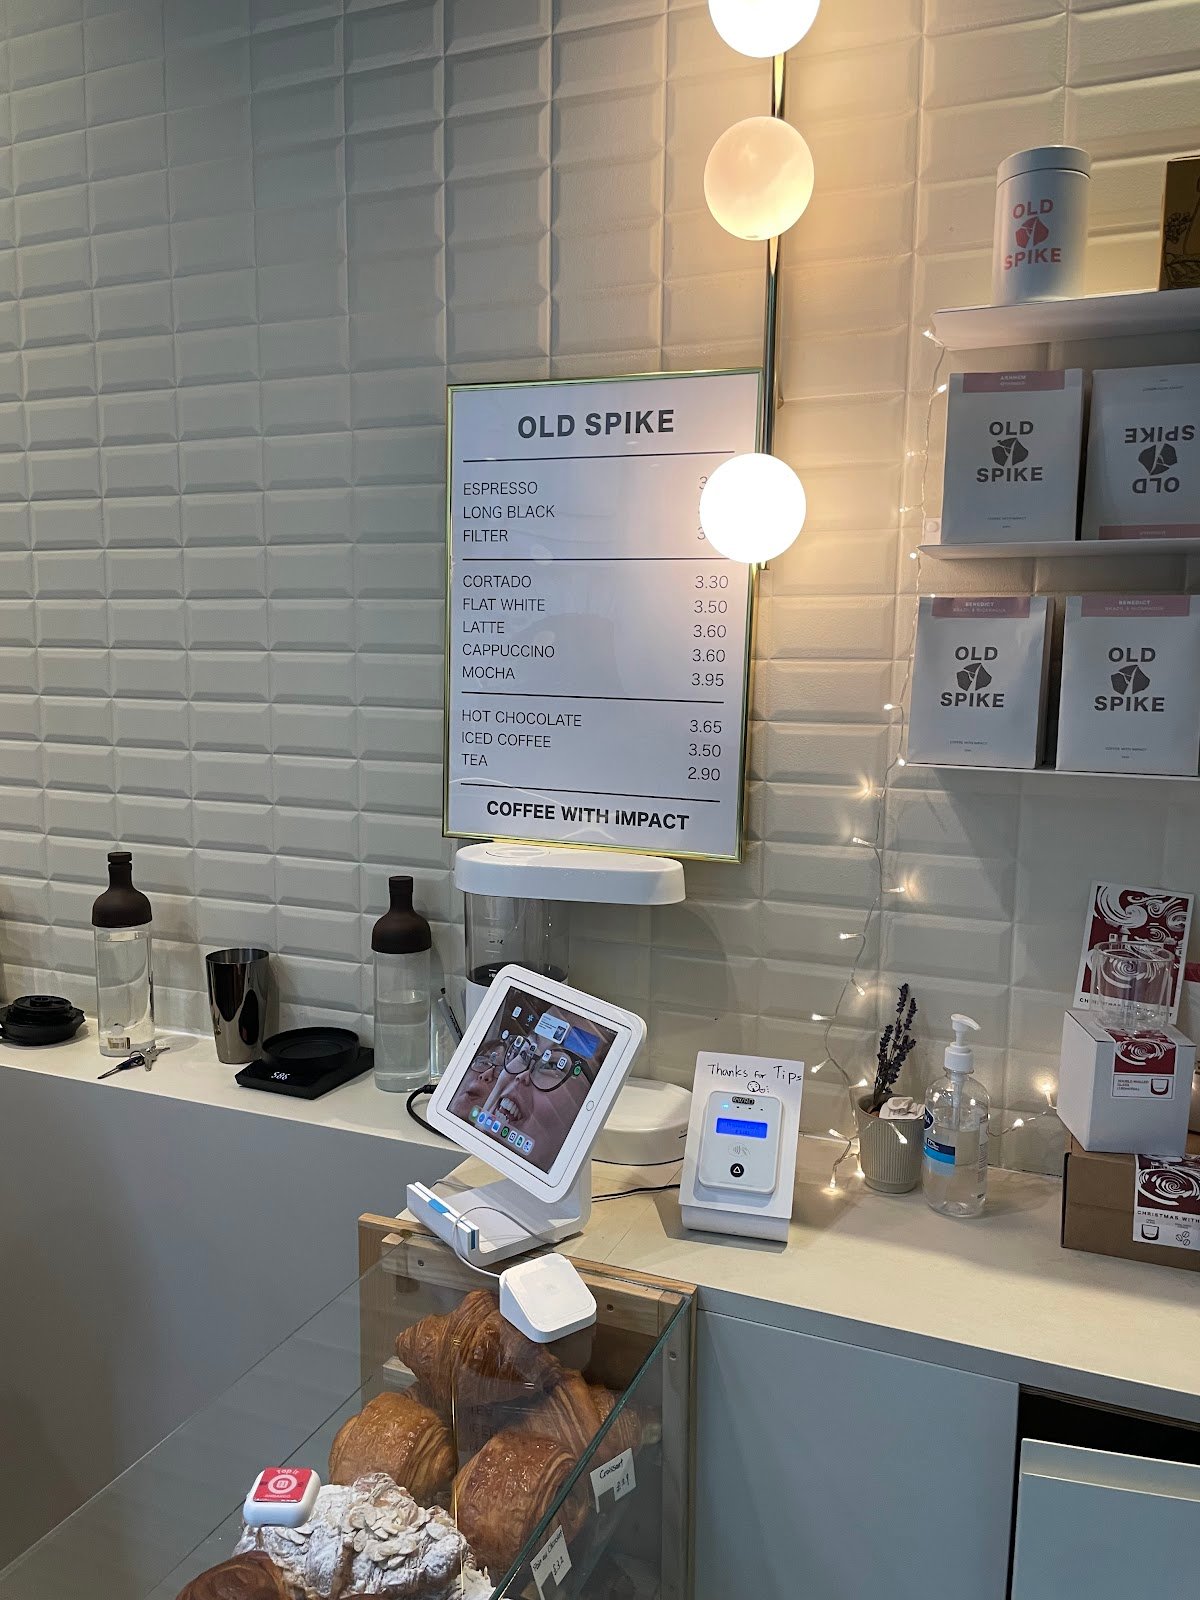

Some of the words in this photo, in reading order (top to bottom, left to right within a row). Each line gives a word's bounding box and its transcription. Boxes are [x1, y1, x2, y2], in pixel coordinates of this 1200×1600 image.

[1012, 199, 1054, 219] OLD
[1003, 247, 1062, 270] SPIKE
[517, 414, 576, 439] OLD
[584, 409, 675, 437] SPIKE
[988, 420, 1034, 436] OLD
[1124, 424, 1196, 444] SPIKE
[975, 466, 1043, 483] SPIKE
[463, 481, 538, 496] ESPRESSO
[1131, 477, 1180, 494] OLD
[463, 505, 502, 519] LONG
[507, 504, 555, 519] BLACK
[463, 529, 509, 543] FILTER
[462, 574, 532, 589] CORTADO
[694, 575, 729, 589] 3.30
[463, 597, 497, 611] FLAT
[500, 598, 545, 612] WHITE
[693, 599, 728, 614] 3.50
[462, 620, 505, 635] LATTE
[692, 624, 727, 639] 3.60
[462, 643, 555, 659] CAPPUCCINO
[691, 648, 726, 663] 3.60
[954, 646, 998, 662] OLD
[1108, 647, 1156, 663] OLD
[462, 665, 516, 680] MOCHA
[691, 672, 724, 687] 3.95
[940, 691, 1005, 708] SPIKE
[1093, 695, 1165, 713] SPIKE
[462, 709, 491, 723] HOT
[495, 710, 582, 727] CHOCOLATE
[689, 719, 722, 734] 3.65
[461, 731, 493, 745] ICED
[497, 733, 551, 748] COFFEE
[688, 743, 722, 758] 3.50
[461, 753, 488, 767] TEA
[687, 766, 721, 781] 2.90
[486, 800, 556, 820] COFFEE
[561, 805, 609, 824] WITH
[615, 809, 690, 831] IMPACT
[707, 1062, 749, 1078] Thanks
[773, 1065, 802, 1085] Tips
[1137, 1210, 1179, 1220] CHRISTMAS
[1182, 1216, 1200, 1224] WITH
